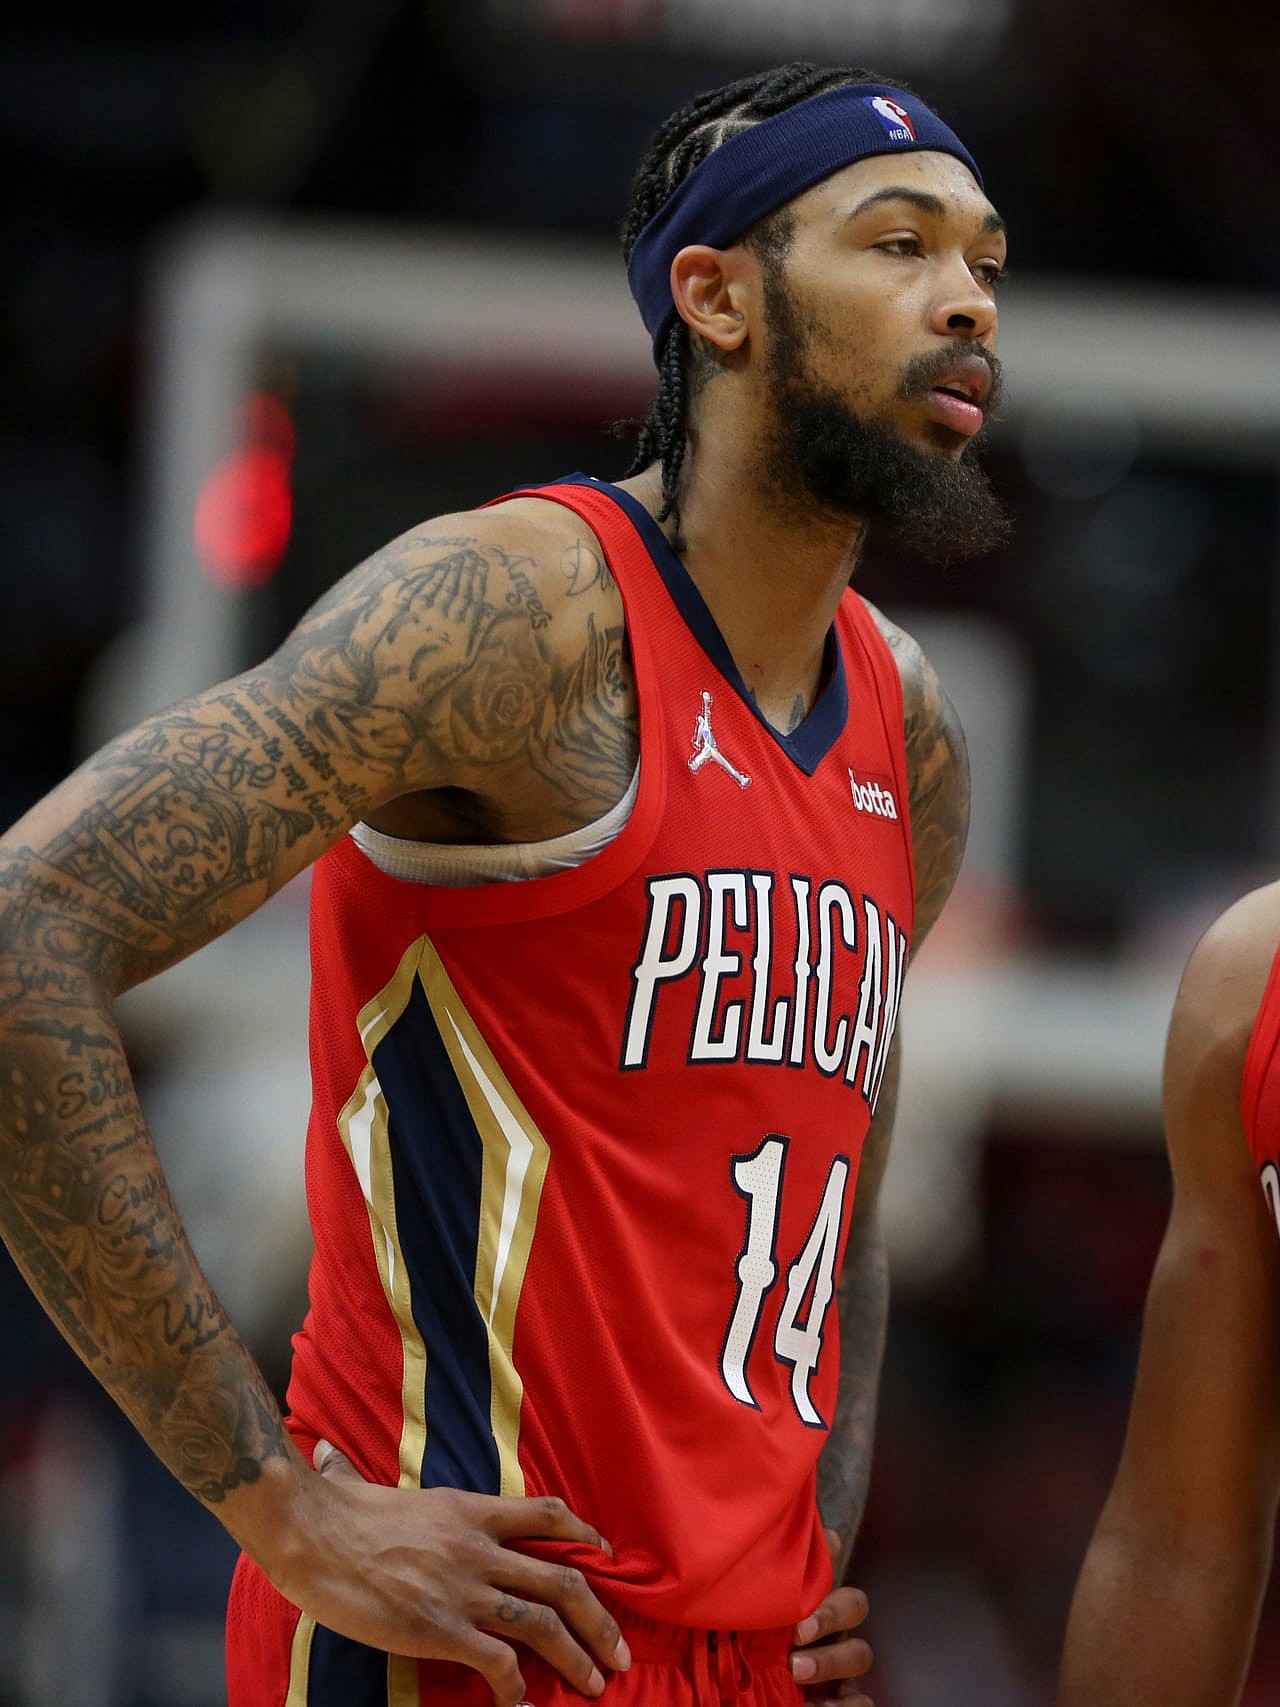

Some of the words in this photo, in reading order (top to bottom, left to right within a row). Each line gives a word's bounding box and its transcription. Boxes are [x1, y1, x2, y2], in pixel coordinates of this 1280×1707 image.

[888, 129, 911, 141] NBA
[618, 867, 907, 1119] PELICAN
[719, 1133, 850, 1431] 14
